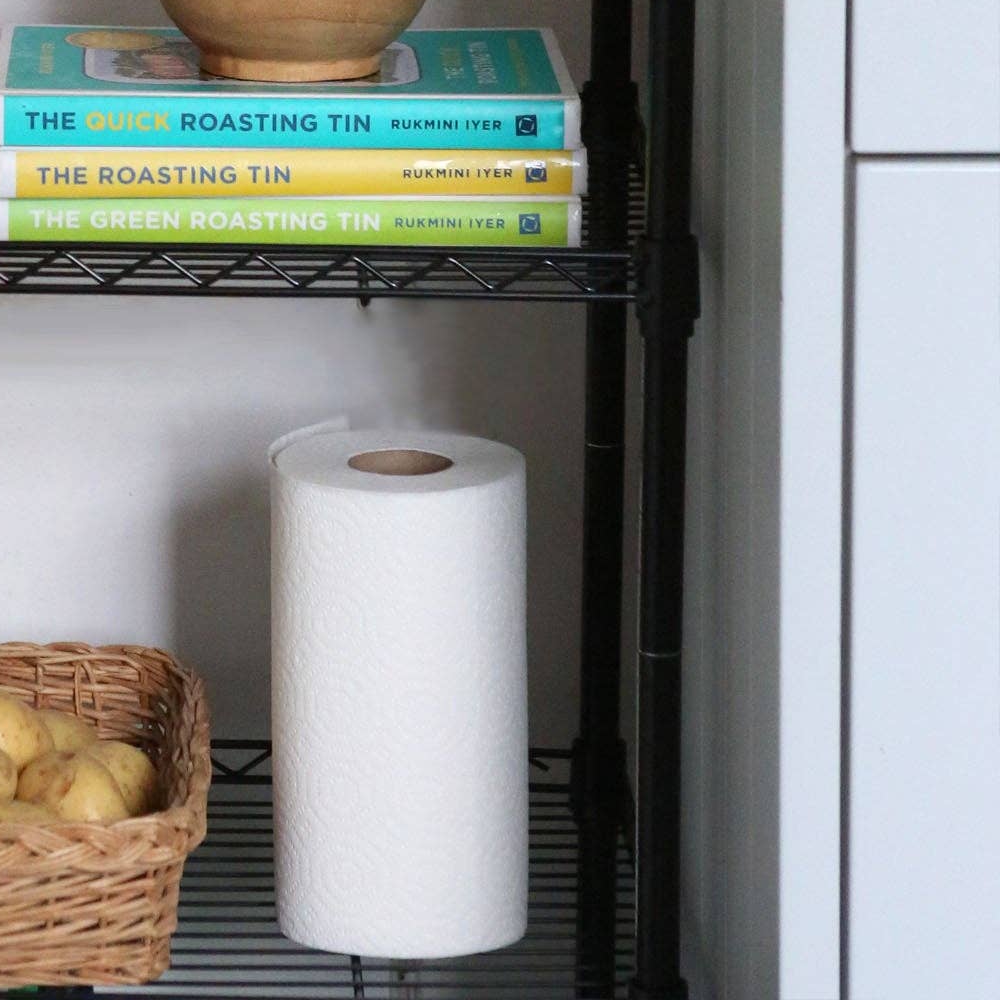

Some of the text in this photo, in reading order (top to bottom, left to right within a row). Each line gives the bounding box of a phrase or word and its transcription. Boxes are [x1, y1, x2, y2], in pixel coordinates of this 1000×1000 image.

[25, 111, 371, 133] THE QUICK ROASTING TIN
[391, 119, 502, 130] RUKMINI IYER
[36, 166, 291, 185] THE ROASTING TIN
[402, 168, 513, 180] RUKMINI IYER
[30, 210, 380, 231] THE GREEN ROASTING TIN
[394, 218, 506, 229] RUKMINI IYER
